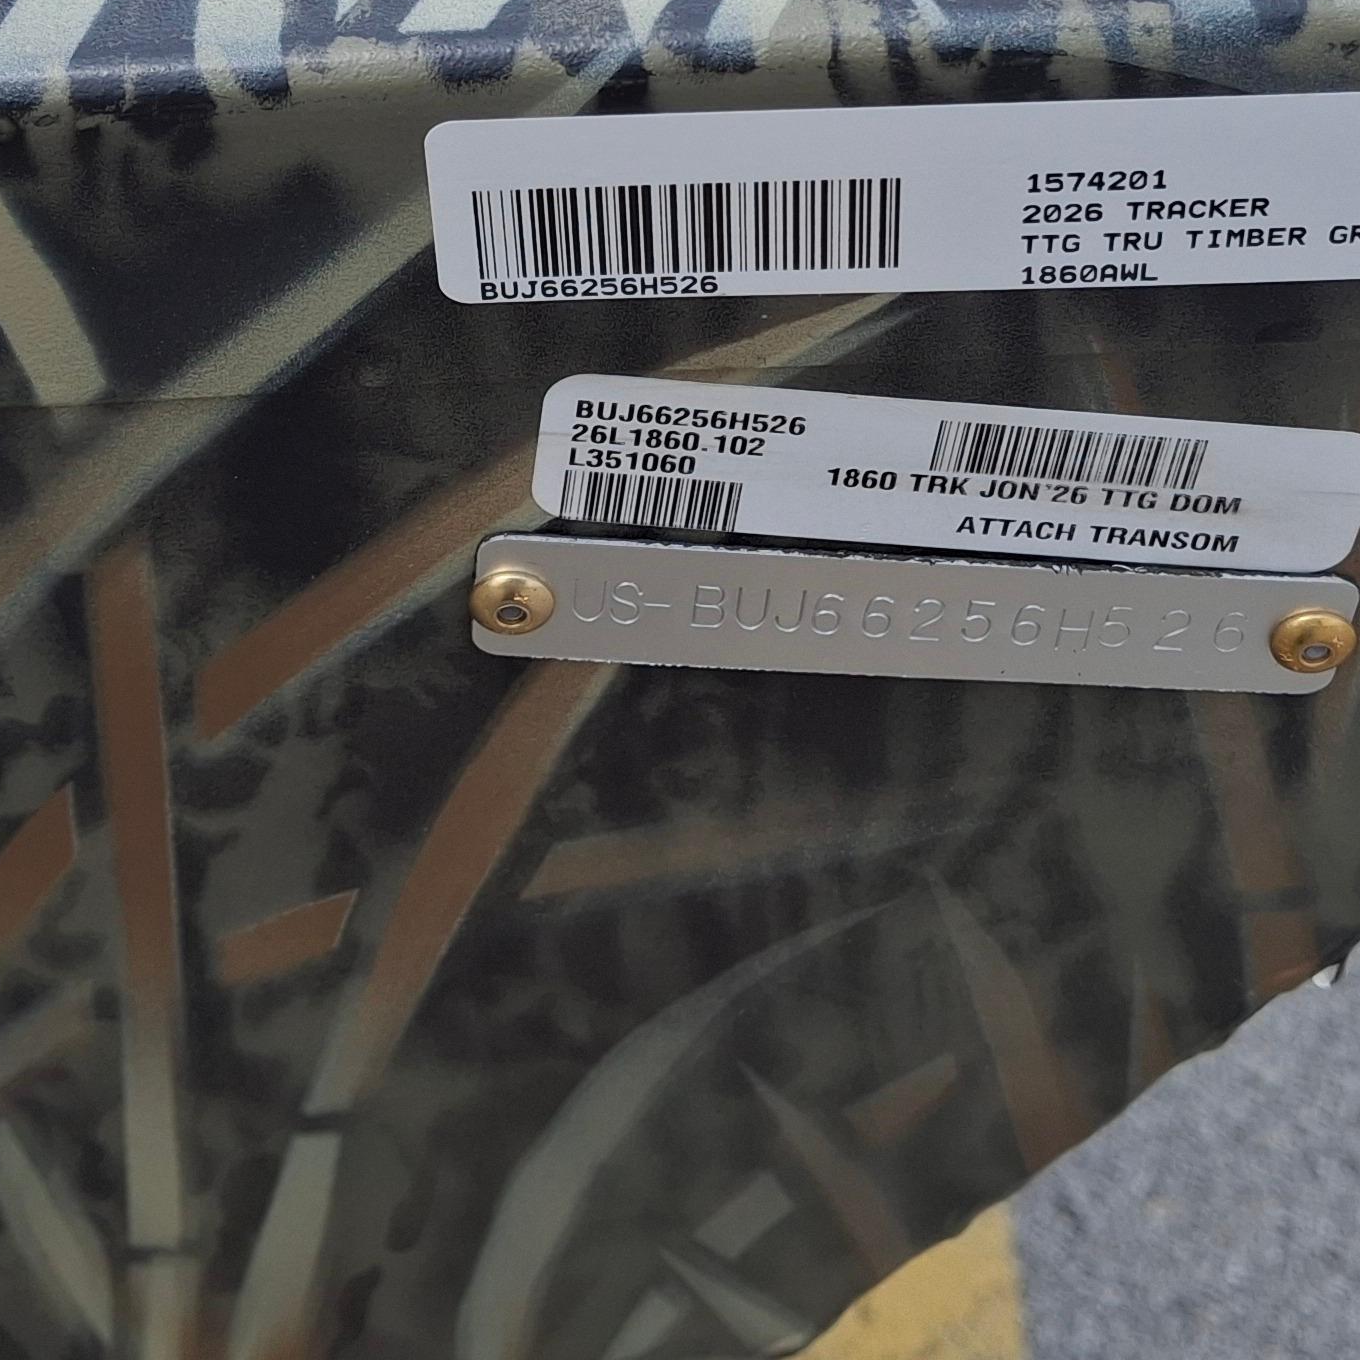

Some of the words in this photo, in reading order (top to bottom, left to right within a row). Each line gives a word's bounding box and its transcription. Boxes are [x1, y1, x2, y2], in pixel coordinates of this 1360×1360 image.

[1026, 169, 1168, 193] 1574201
[1021, 202, 1104, 224] 2026
[1126, 197, 1270, 221] TRACKER
[1020, 233, 1081, 254] TTG
[1102, 230, 1164, 252] TRU
[1185, 226, 1308, 250] TIMBER
[480, 274, 719, 301] BUJ66256H526
[1020, 262, 1159, 285] 1860AWL
[575, 399, 807, 436] BUJ66256H526
[568, 447, 697, 475] L351060
[827, 467, 898, 491] 1860
[909, 473, 971, 496] TRK
[1101, 487, 1158, 510] TTG
[1168, 493, 1242, 515] DOM
[955, 516, 1077, 542] ATTACH
[1089, 524, 1240, 553] TRANSOM
